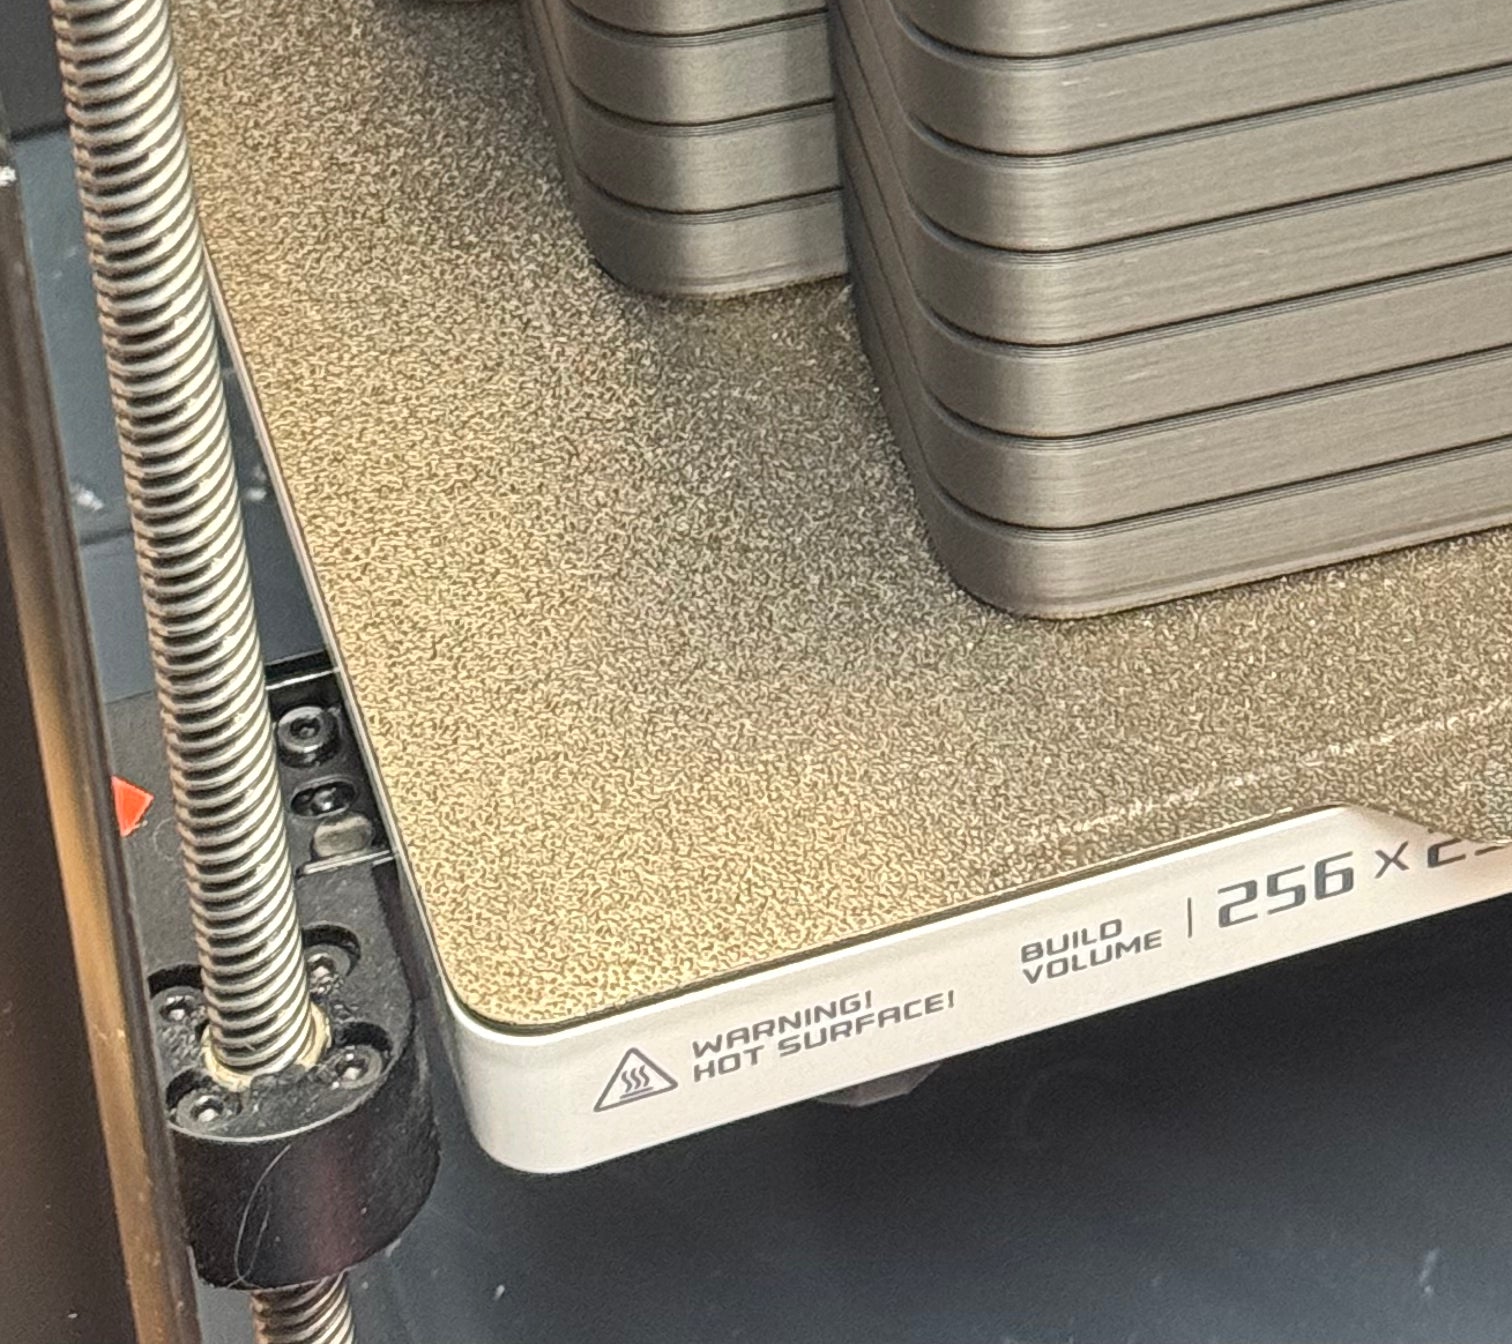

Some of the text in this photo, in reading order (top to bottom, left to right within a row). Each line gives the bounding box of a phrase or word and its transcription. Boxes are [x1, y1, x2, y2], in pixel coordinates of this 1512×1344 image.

[1217, 850, 1354, 928] 256
[1020, 918, 1123, 964] BUILD
[1021, 928, 1163, 985] VOLUME
[691, 990, 873, 1059] WARNING!
[692, 989, 956, 1083] HOT SURFACE!
